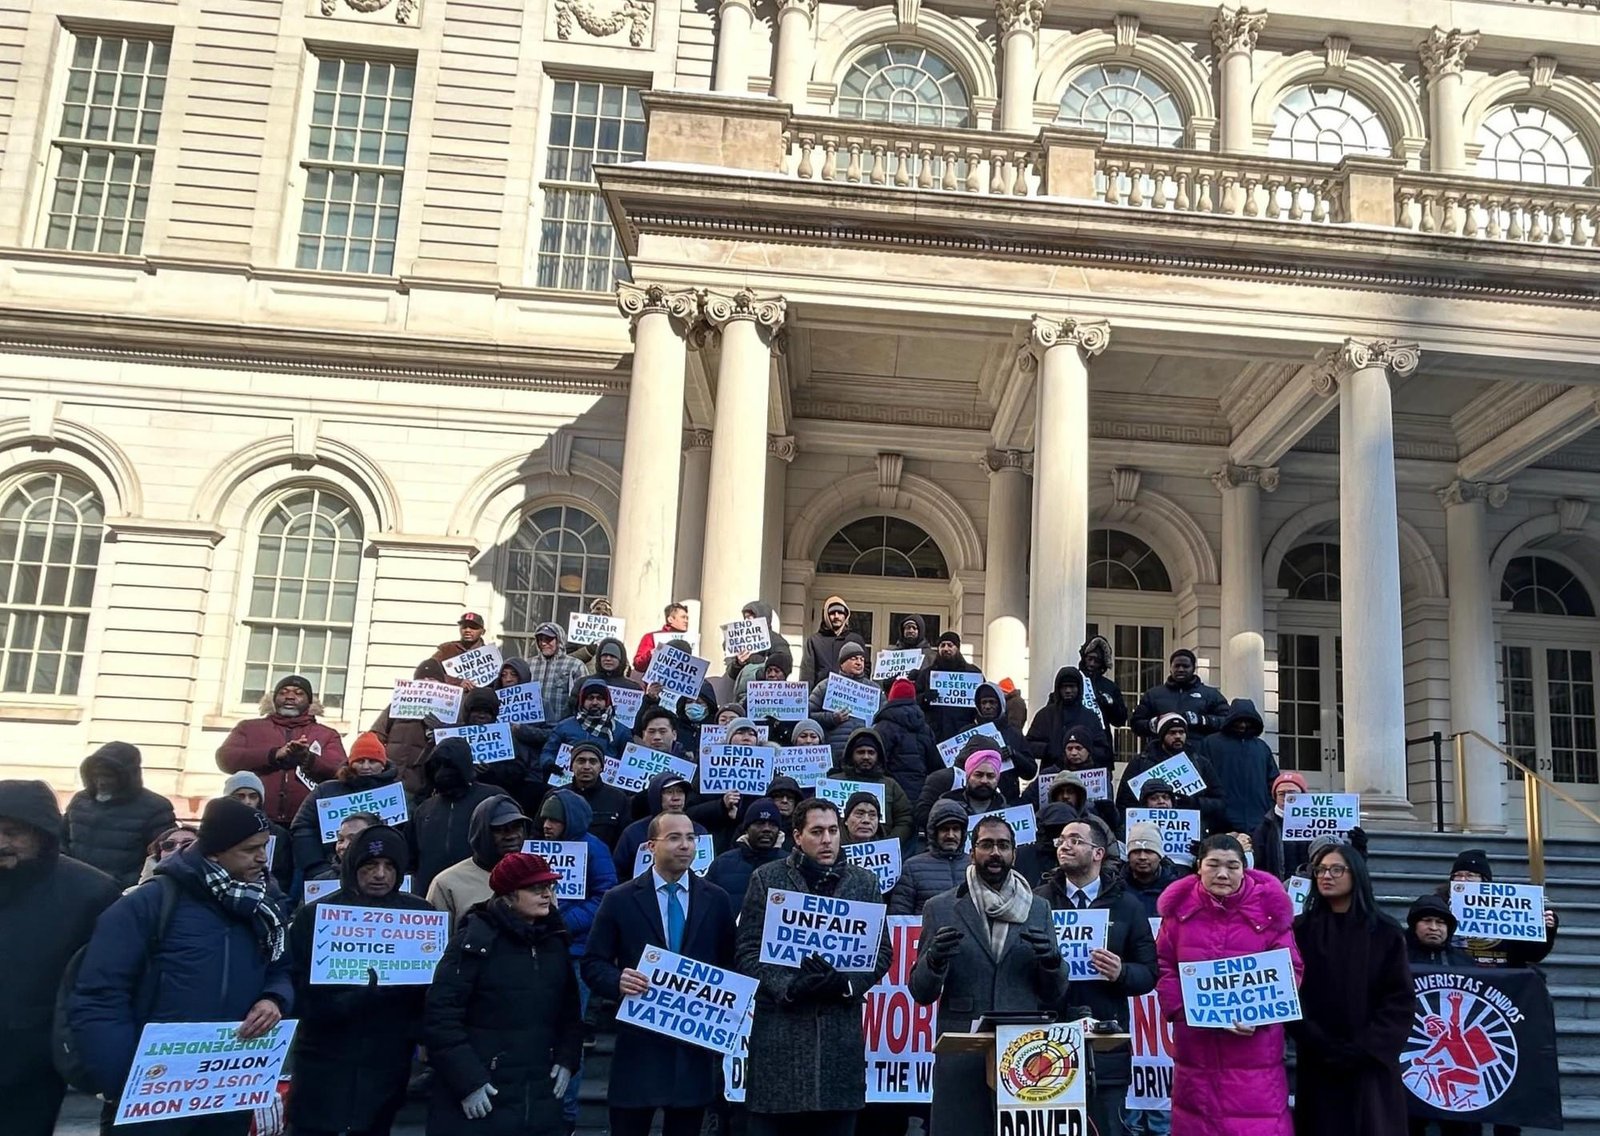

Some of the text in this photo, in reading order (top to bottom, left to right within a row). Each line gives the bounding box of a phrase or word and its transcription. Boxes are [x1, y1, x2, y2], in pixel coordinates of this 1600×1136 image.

[587, 615, 609, 624] END
[734, 620, 752, 629] END
[577, 622, 617, 632] UNFAIR
[728, 626, 761, 637] UNFAIR
[730, 635, 764, 645] DEACTI-
[460, 650, 481, 663] END
[667, 647, 690, 663] END
[880, 657, 916, 666] DESERVE
[454, 654, 494, 673] UNFAIR
[657, 653, 698, 676] UNFAIR
[652, 662, 695, 684] DEACTI-
[436, 685, 460, 695] NOW!
[500, 686, 521, 698] END
[935, 681, 978, 690] DESERVE
[426, 691, 455, 700] CAUSE
[499, 692, 533, 705] NFAIR
[833, 691, 858, 703] NOTICE
[499, 702, 535, 715] EACTI-
[496, 711, 542, 723] TIONS!
[458, 724, 487, 736] END
[955, 729, 978, 744] END
[468, 732, 501, 743] FAIR
[723, 746, 753, 756] END
[650, 752, 671, 766] WE
[710, 757, 765, 769] UNFAIR
[709, 768, 765, 779] DEACTI-
[1080, 771, 1104, 779] NOW!
[1148, 764, 1168, 778] WE
[1160, 765, 1189, 784] ERVE
[841, 782, 860, 791] WE
[348, 792, 373, 805] WE
[1311, 795, 1333, 806] WE
[328, 796, 398, 819] DESERVE
[1292, 807, 1353, 818] DESERVE
[1149, 810, 1178, 820] END
[1307, 819, 1338, 829] JOB
[1162, 831, 1192, 841] CTI-
[530, 842, 562, 854] END
[848, 853, 891, 867] FAIR
[1480, 884, 1516, 896] END
[803, 895, 850, 917] END
[1464, 895, 1532, 910] UNFAIR
[322, 909, 443, 926] INT. 276 NOW!
[782, 908, 867, 936] UNFAIR
[1053, 911, 1078, 925] ND
[1463, 907, 1535, 923] DEACTI-
[331, 926, 436, 940] JUST CAUSE
[1457, 920, 1542, 938] VATIONS!
[777, 925, 867, 952] DEACTI-
[330, 942, 395, 954] NOTICE
[767, 942, 872, 968] VATONS!
[676, 958, 724, 985] END
[1213, 956, 1257, 975] END
[326, 969, 390, 981] APPEL
[1197, 968, 1279, 991] UNFAIR
[651, 968, 737, 1009] UNFAIR
[1197, 985, 1283, 1007] DEACTI-
[641, 986, 731, 1025] DEACTI-
[1190, 999, 1296, 1023] VATIONS!
[1484, 986, 1525, 1024] UNIDOS
[627, 1001, 735, 1049] VATIONS!
[144, 1038, 276, 1056] INDEPENDENT
[197, 1056, 269, 1073] NOTICE
[875, 1061, 910, 1092] THE
[139, 1074, 263, 1095] JUST CAUSE
[123, 1091, 269, 1118] INT. 276 NOW!
